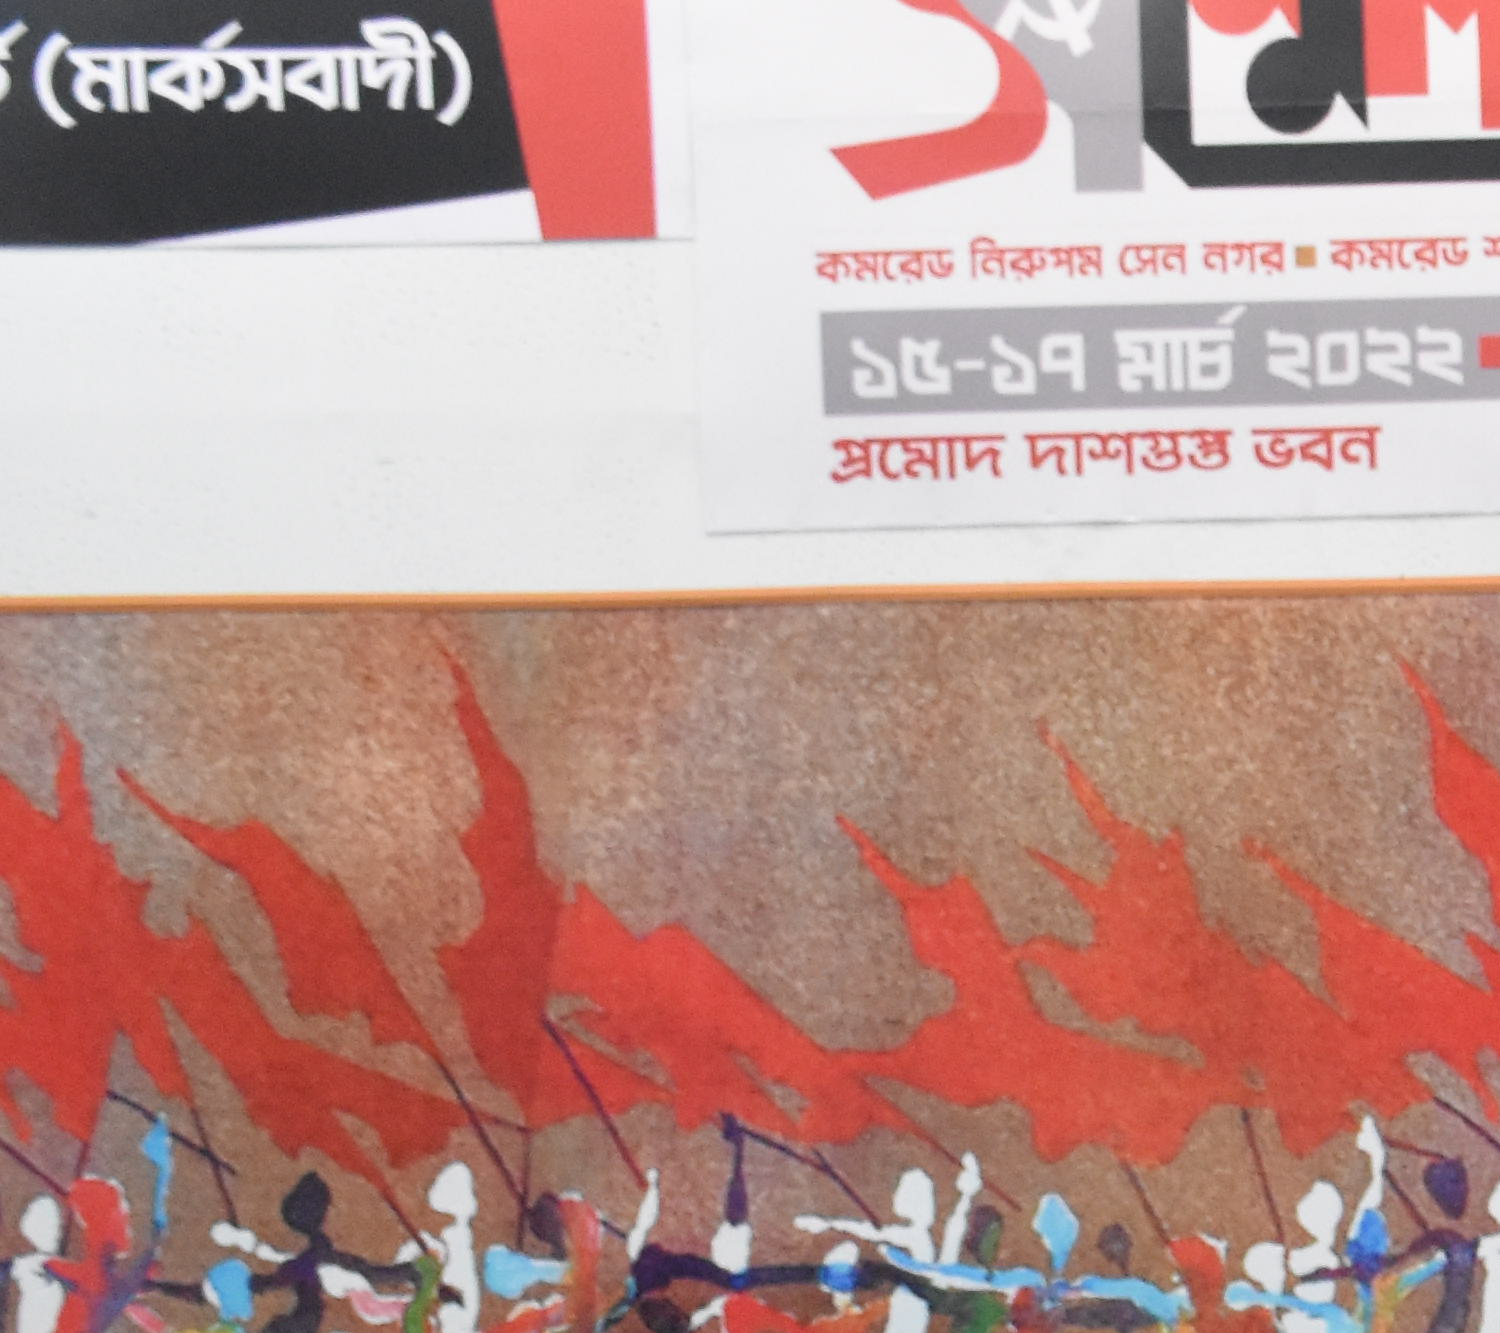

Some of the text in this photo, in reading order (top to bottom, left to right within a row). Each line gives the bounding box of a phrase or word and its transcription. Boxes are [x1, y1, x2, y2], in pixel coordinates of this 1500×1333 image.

[34, 16, 473, 129] (মার্কসবাদী)
[815, 249, 955, 284] কমরেড
[970, 236, 1102, 280] নিরুপম
[1119, 242, 1186, 276] সেন
[1202, 240, 1286, 275] নগর
[1329, 237, 1469, 272] কমরেড
[849, 331, 1086, 400] ১৫-১৭
[1113, 304, 1249, 393] মার্চ
[1264, 325, 1465, 390] ২০২২
[829, 433, 1006, 484] প্রমোদ
[1251, 424, 1382, 471] ভবন
